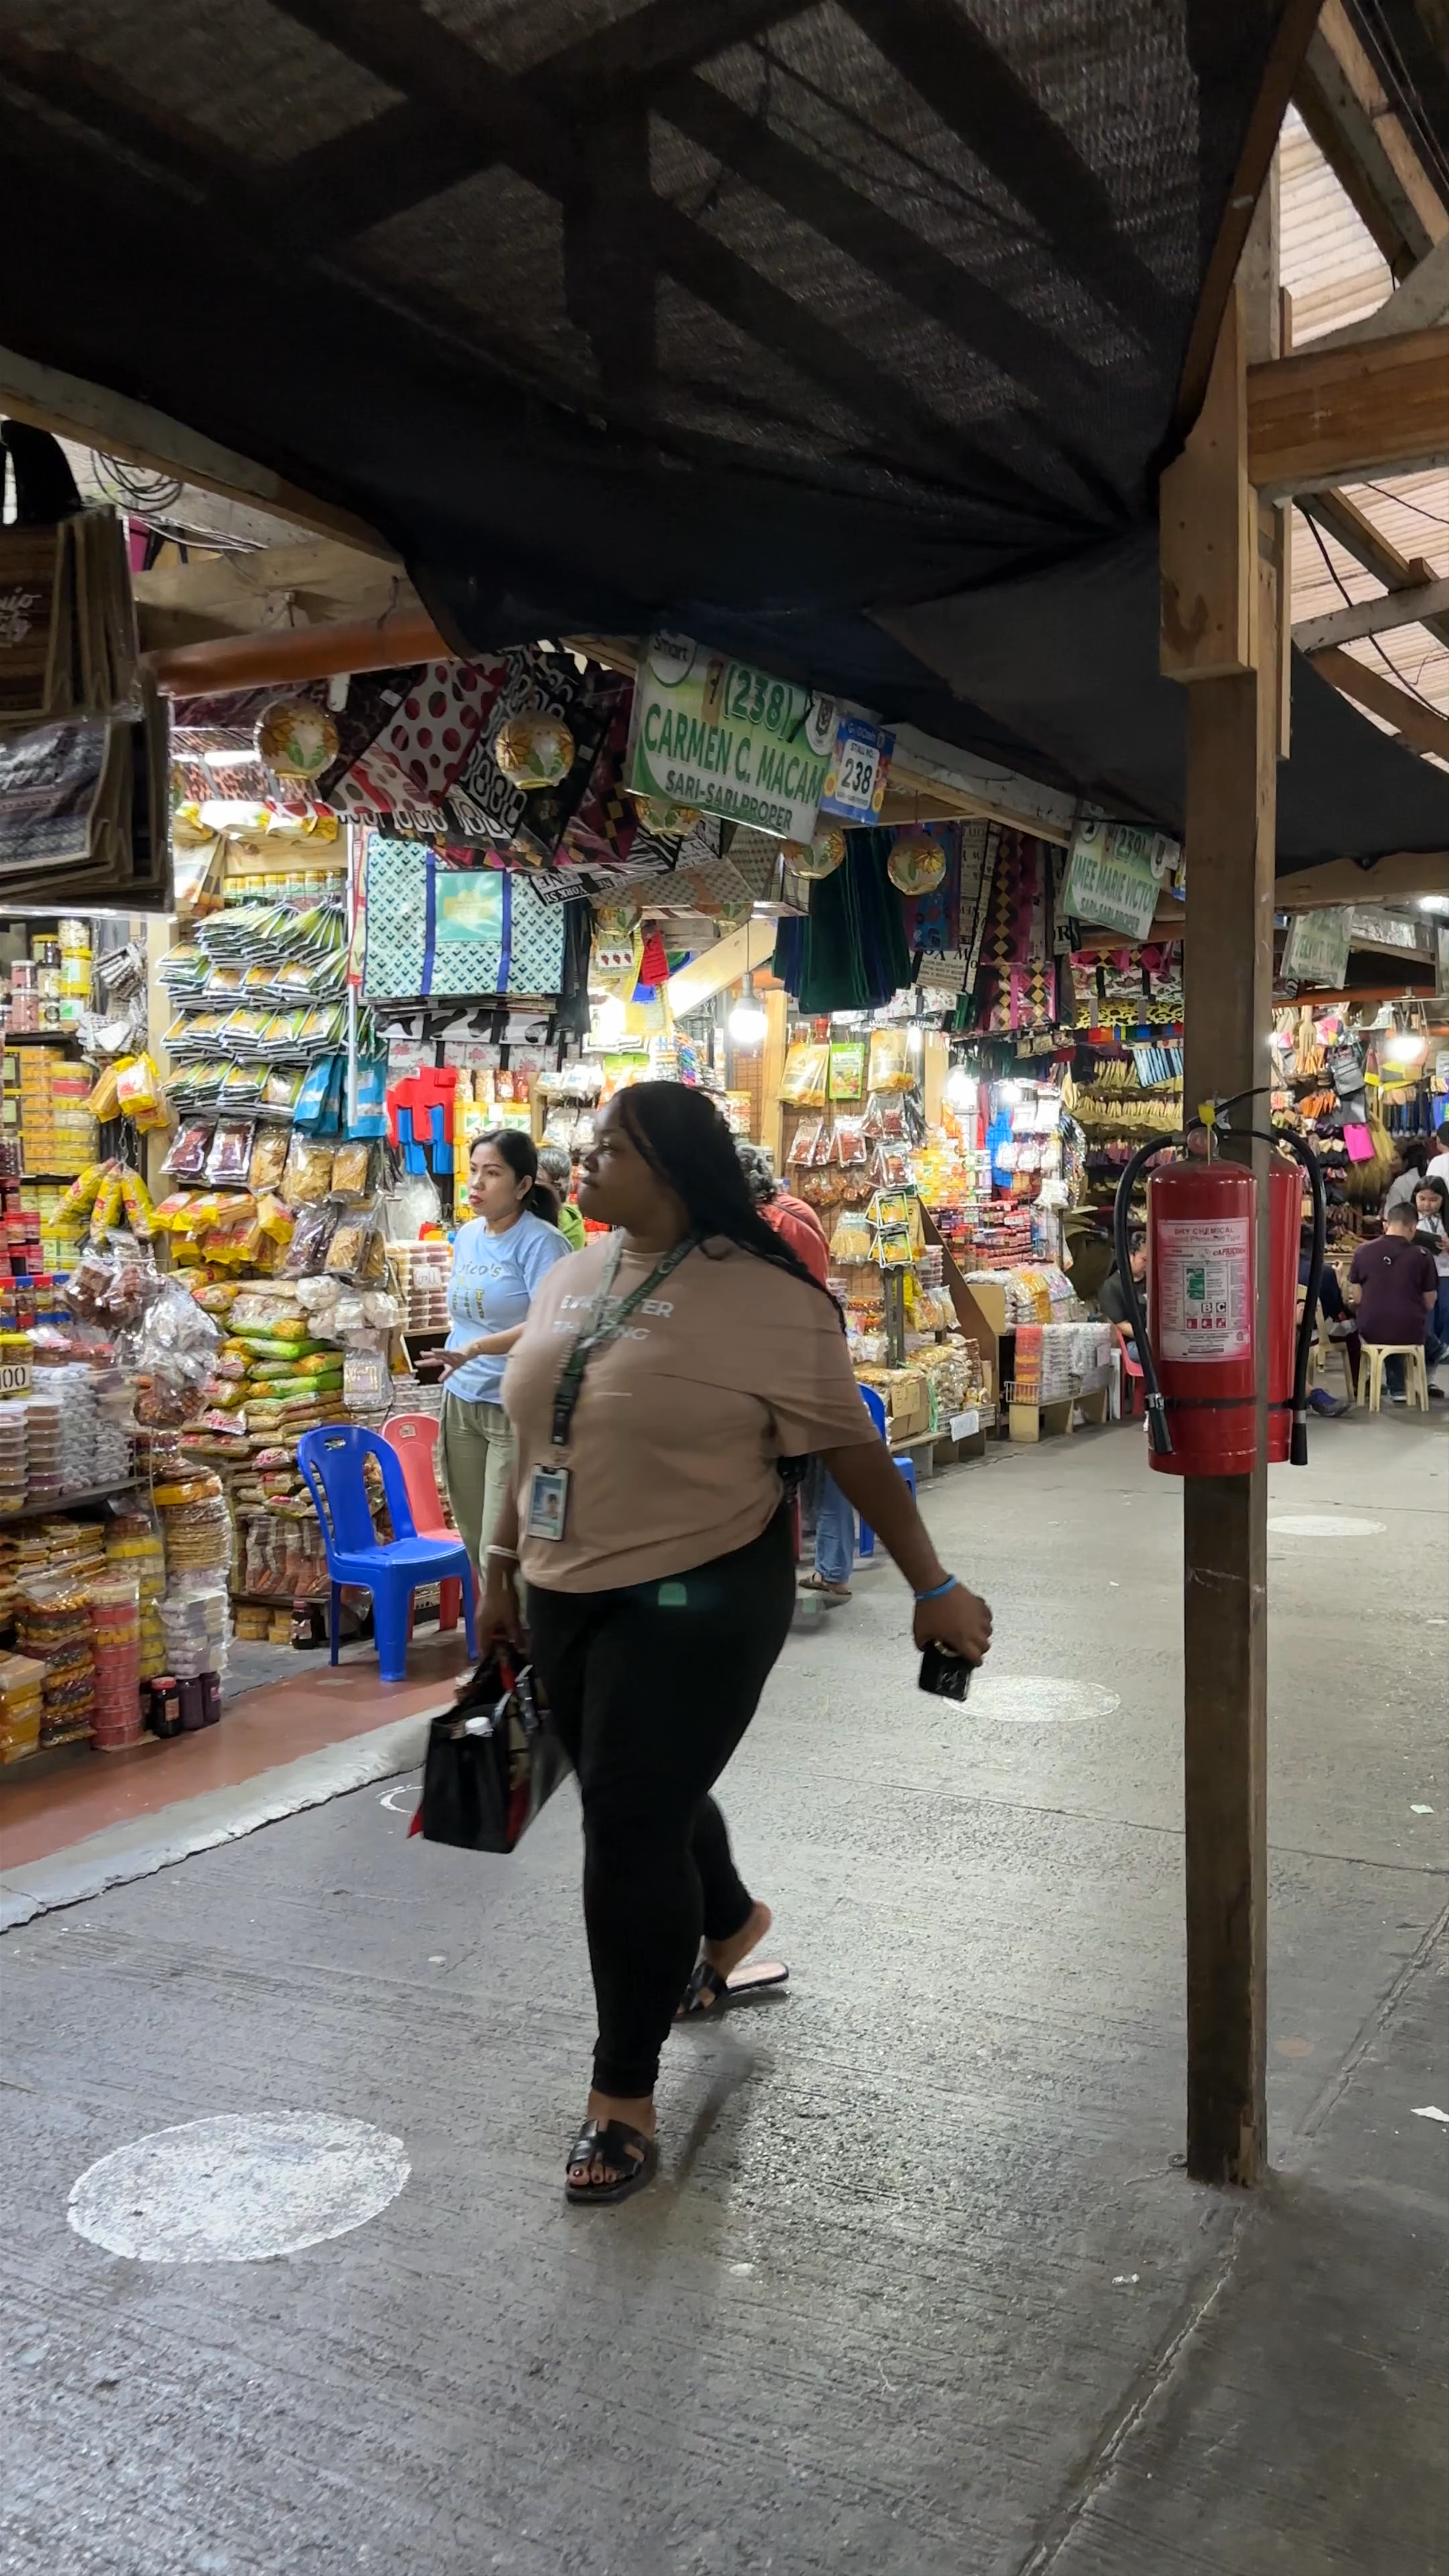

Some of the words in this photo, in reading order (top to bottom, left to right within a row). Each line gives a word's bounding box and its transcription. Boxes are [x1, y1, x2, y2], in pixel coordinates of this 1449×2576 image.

[723, 663, 793, 740] (238)
[645, 703, 733, 776] CARMEN
[735, 737, 751, 784] C.
[841, 758, 872, 795] 238
[665, 770, 738, 810] SARI-SARI
[740, 794, 793, 830] PROPER
[1192, 1227, 1235, 1235] CHEMICAL
[1202, 1303, 1211, 1313] B
[1216, 1303, 1226, 1312] C
[0, 1367, 25, 1390] 00
